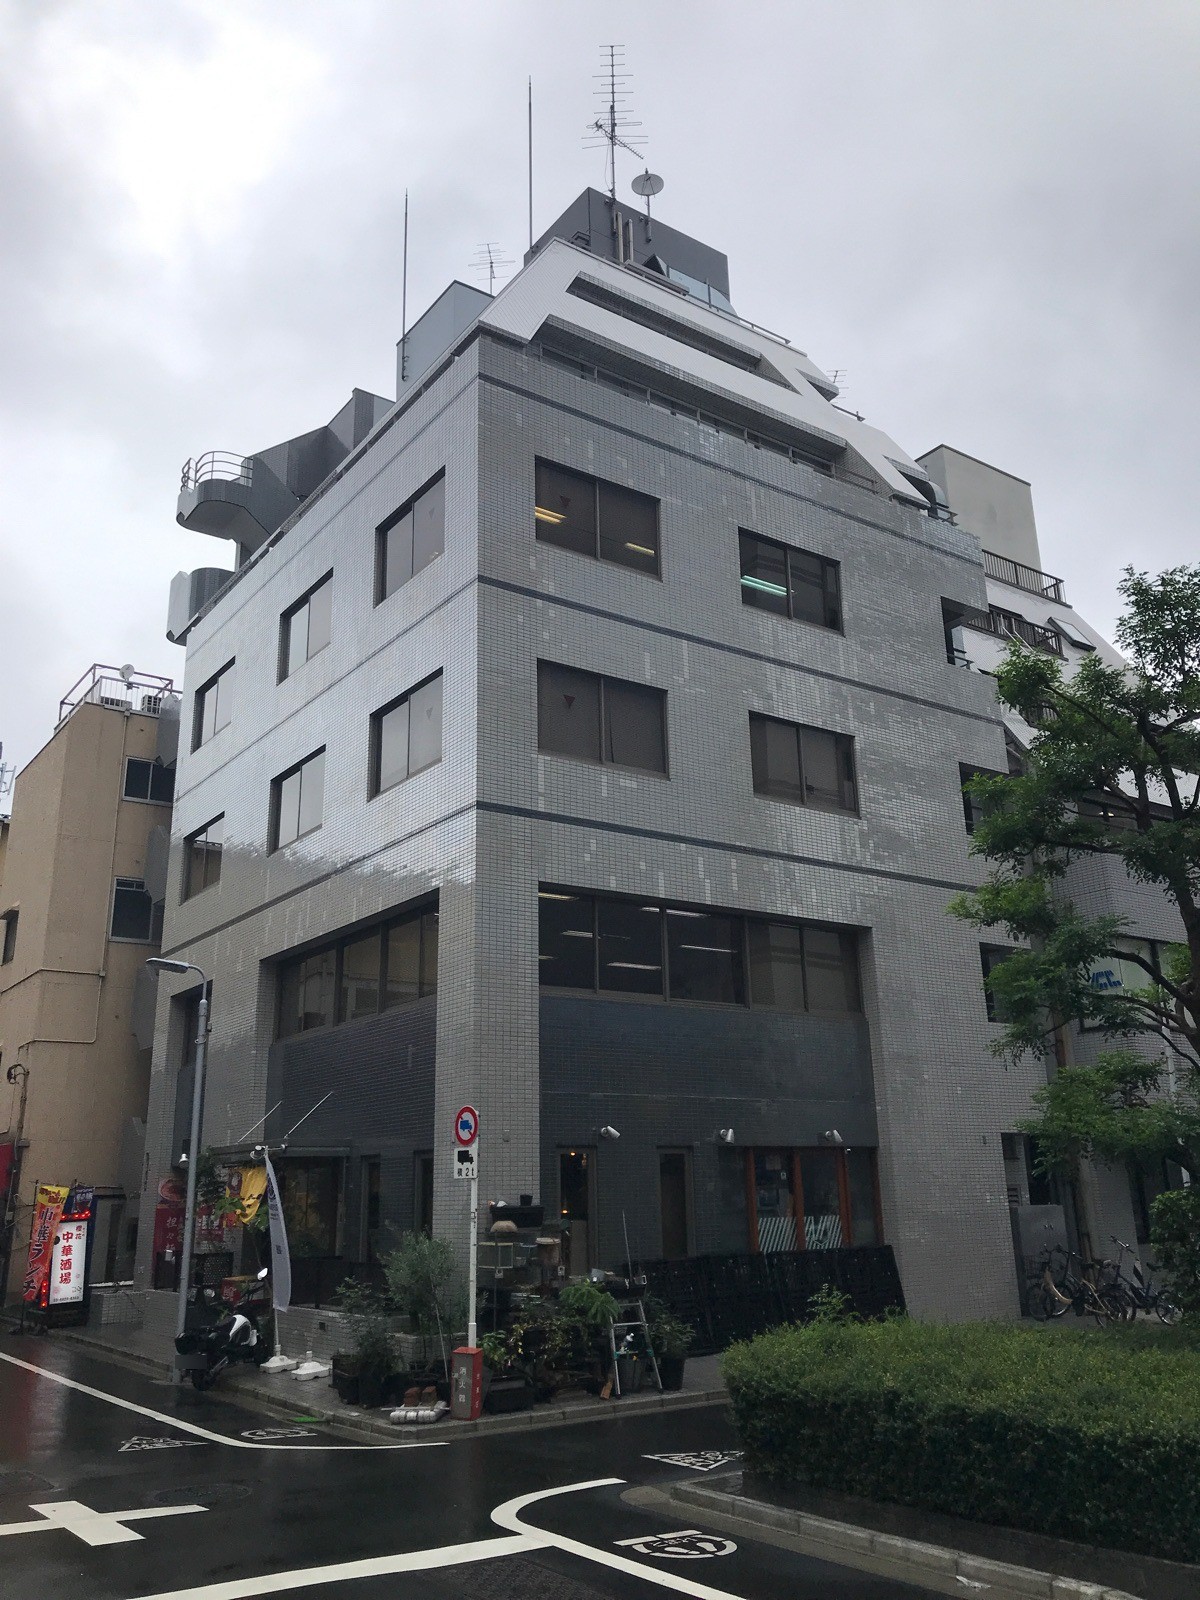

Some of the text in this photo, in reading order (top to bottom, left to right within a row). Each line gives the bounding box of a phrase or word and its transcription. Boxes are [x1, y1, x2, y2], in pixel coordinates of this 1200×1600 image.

[23, 1207, 54, 1294] 中華ランチ
[59, 1231, 74, 1284] 中華酒場
